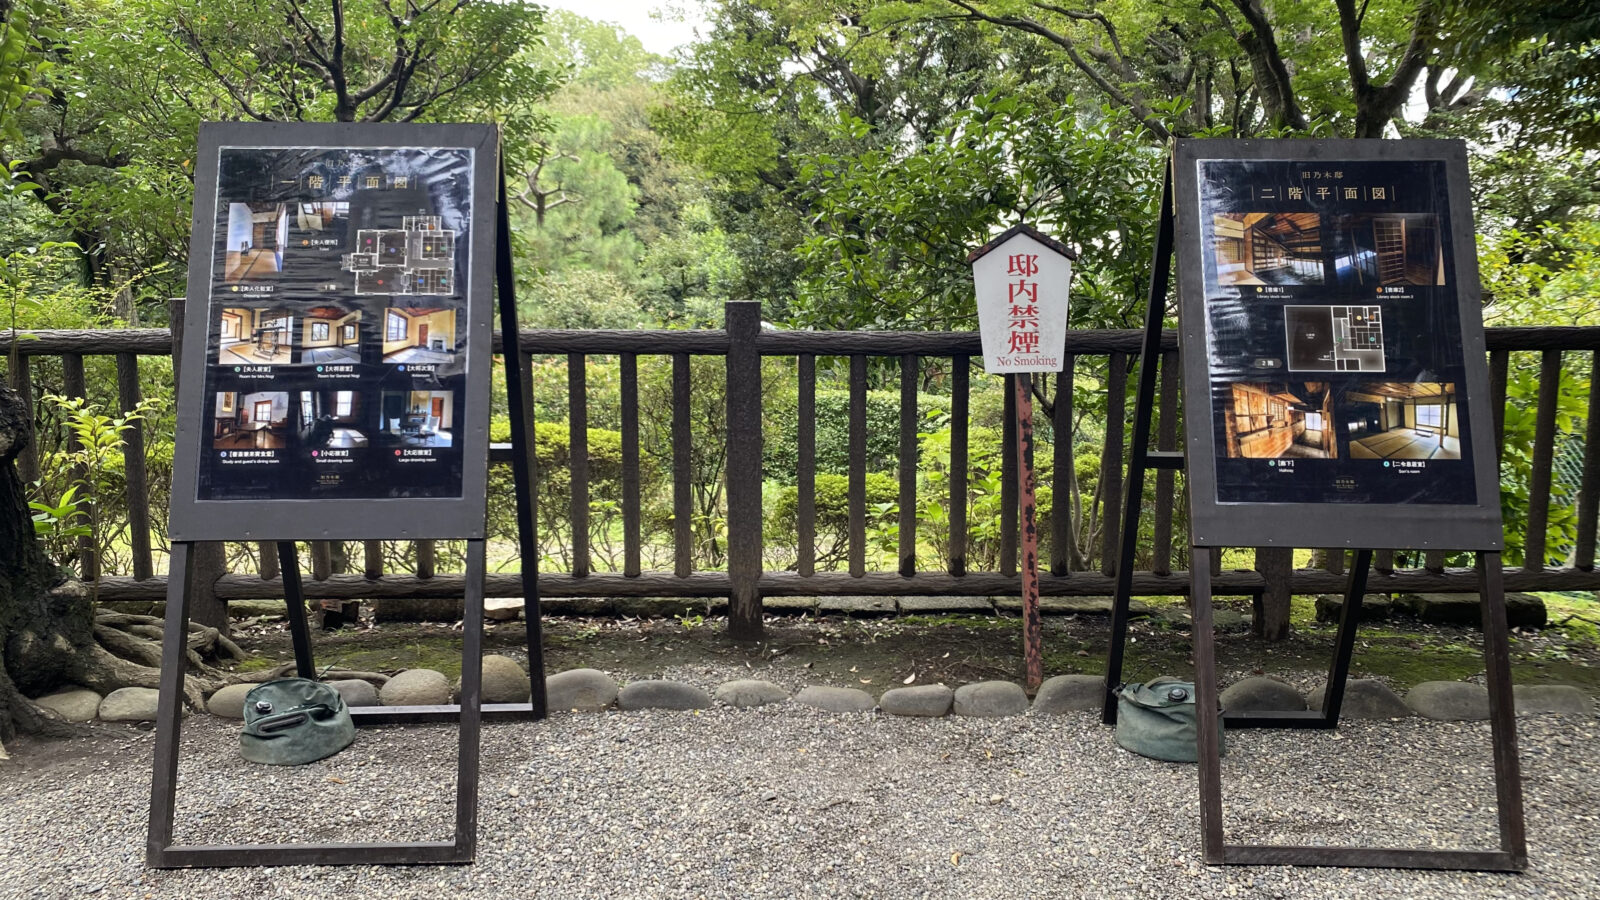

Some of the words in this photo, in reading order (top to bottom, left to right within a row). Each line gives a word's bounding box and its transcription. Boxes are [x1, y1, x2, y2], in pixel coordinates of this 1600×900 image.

[1302, 171, 1344, 180] 旧乃木邸
[1260, 187, 1386, 200] 二階平面図
[1007, 254, 1040, 355] 邸内禁煙
[997, 357, 1012, 367] No
[1014, 356, 1058, 368] Smoking
